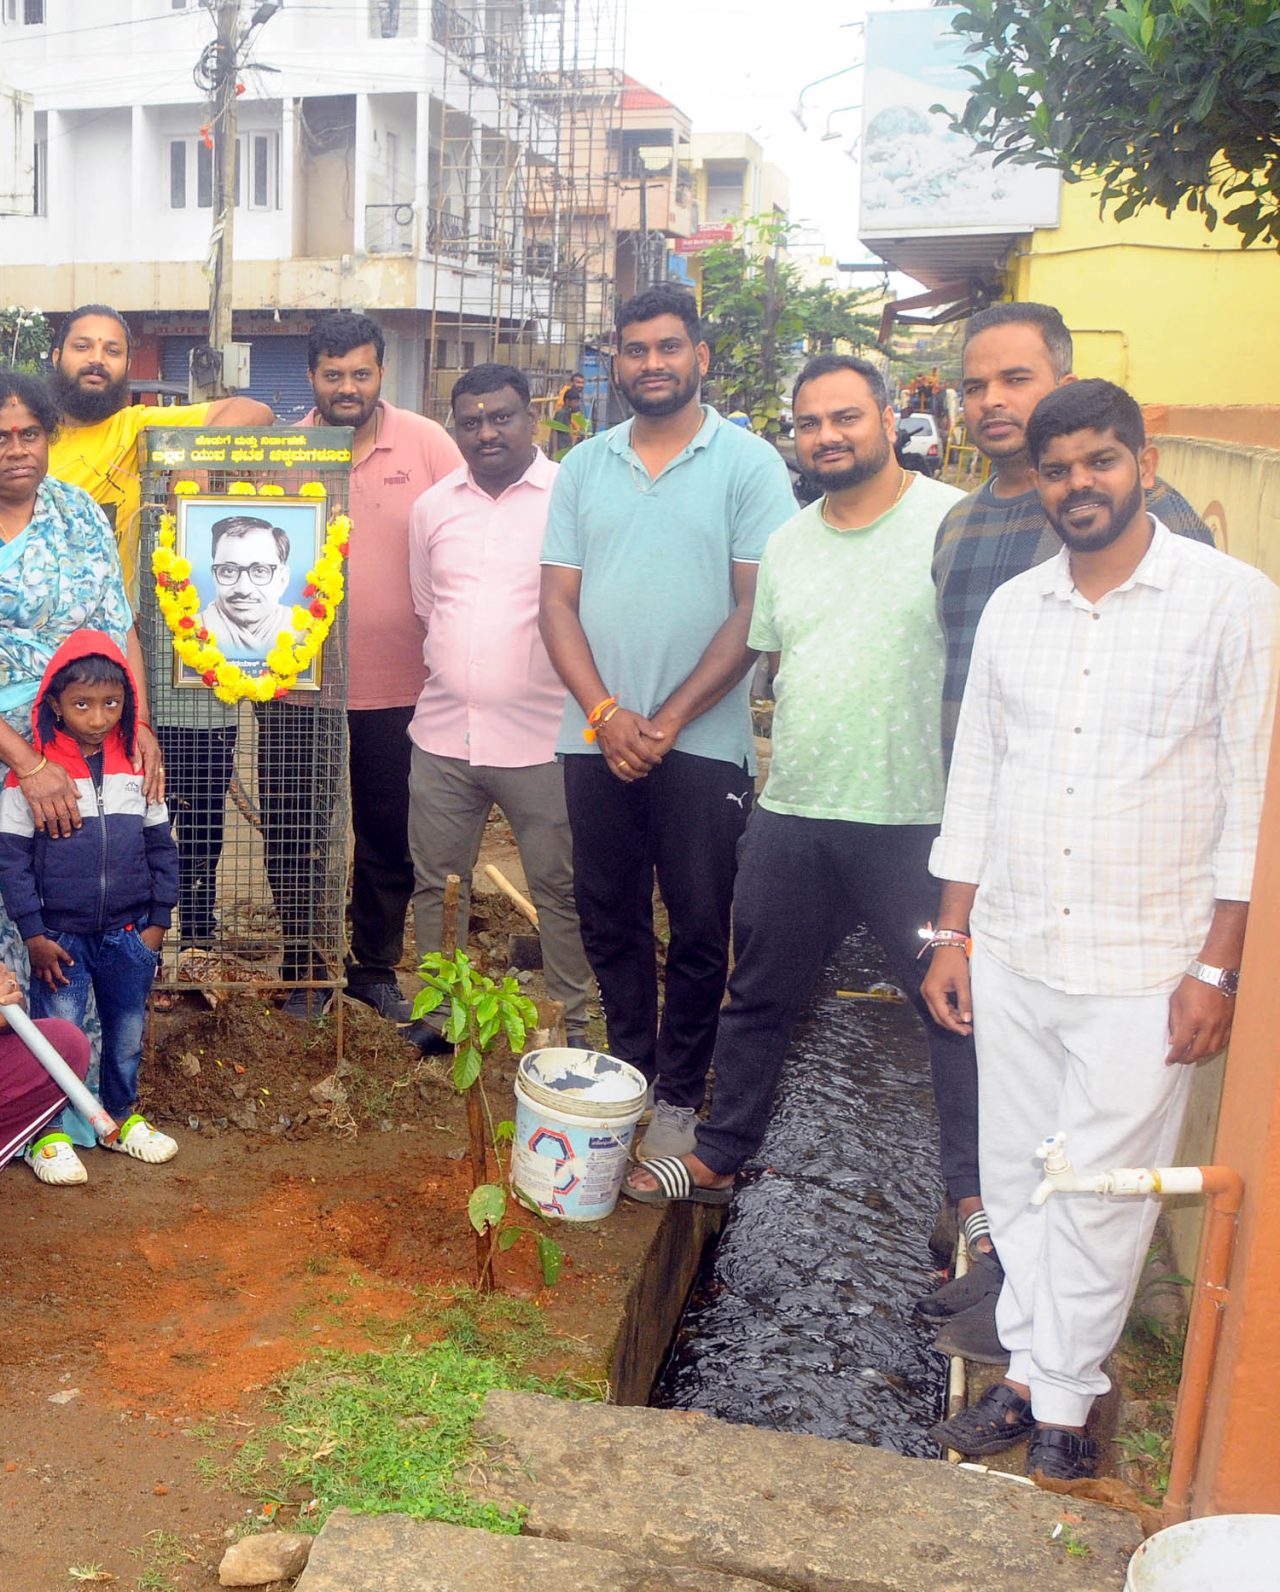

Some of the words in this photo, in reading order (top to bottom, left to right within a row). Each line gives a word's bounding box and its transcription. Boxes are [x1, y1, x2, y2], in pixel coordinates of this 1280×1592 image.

[234, 435, 258, 449] ಮತ್ತು
[191, 448, 225, 461] ಯುವ
[231, 448, 264, 463] ಘಟಕ
[269, 448, 352, 467] ಚಿಕ್ಕಮಗಳೂರು
